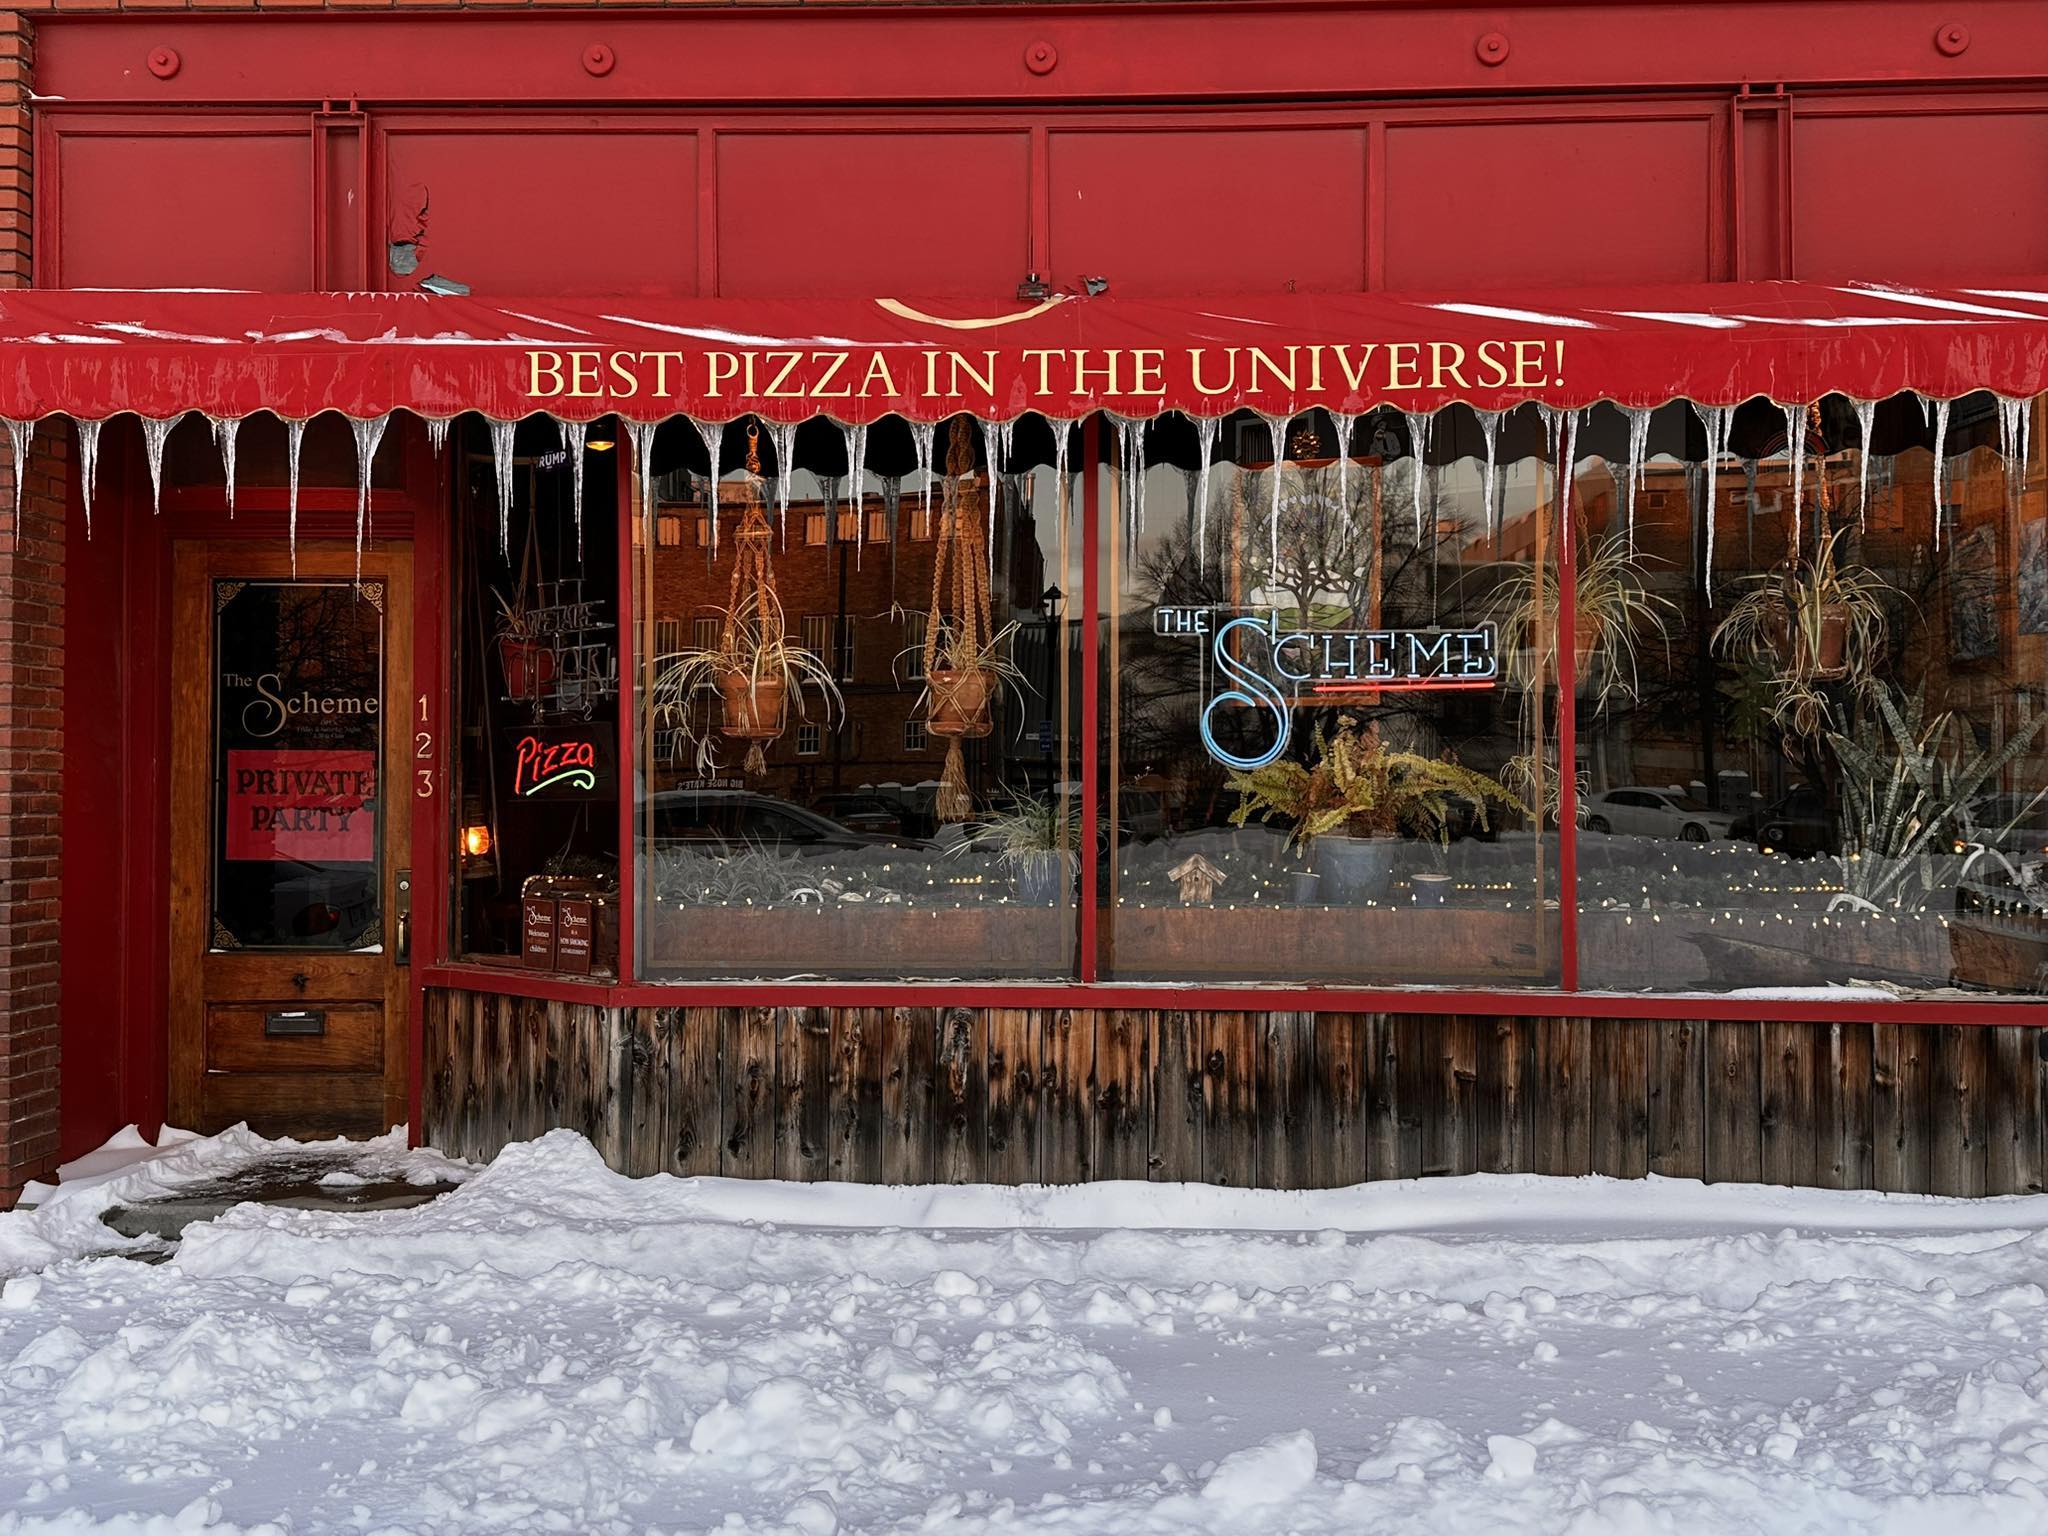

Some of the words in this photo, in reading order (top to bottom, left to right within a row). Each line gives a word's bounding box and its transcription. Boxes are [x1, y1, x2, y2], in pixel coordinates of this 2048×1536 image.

[525, 350, 682, 398] BEST
[703, 350, 900, 398] PIZZA
[921, 350, 1000, 398] IN
[1022, 348, 1168, 396] THE
[1185, 340, 1566, 394] UNIVERSE!
[537, 451, 567, 468] RUMP
[1158, 609, 1210, 633] THE
[223, 673, 253, 688] The
[242, 672, 379, 738] Scheme
[515, 736, 594, 794] Pizza
[236, 768, 371, 796] PRIVATE
[250, 805, 358, 832] PARTY
